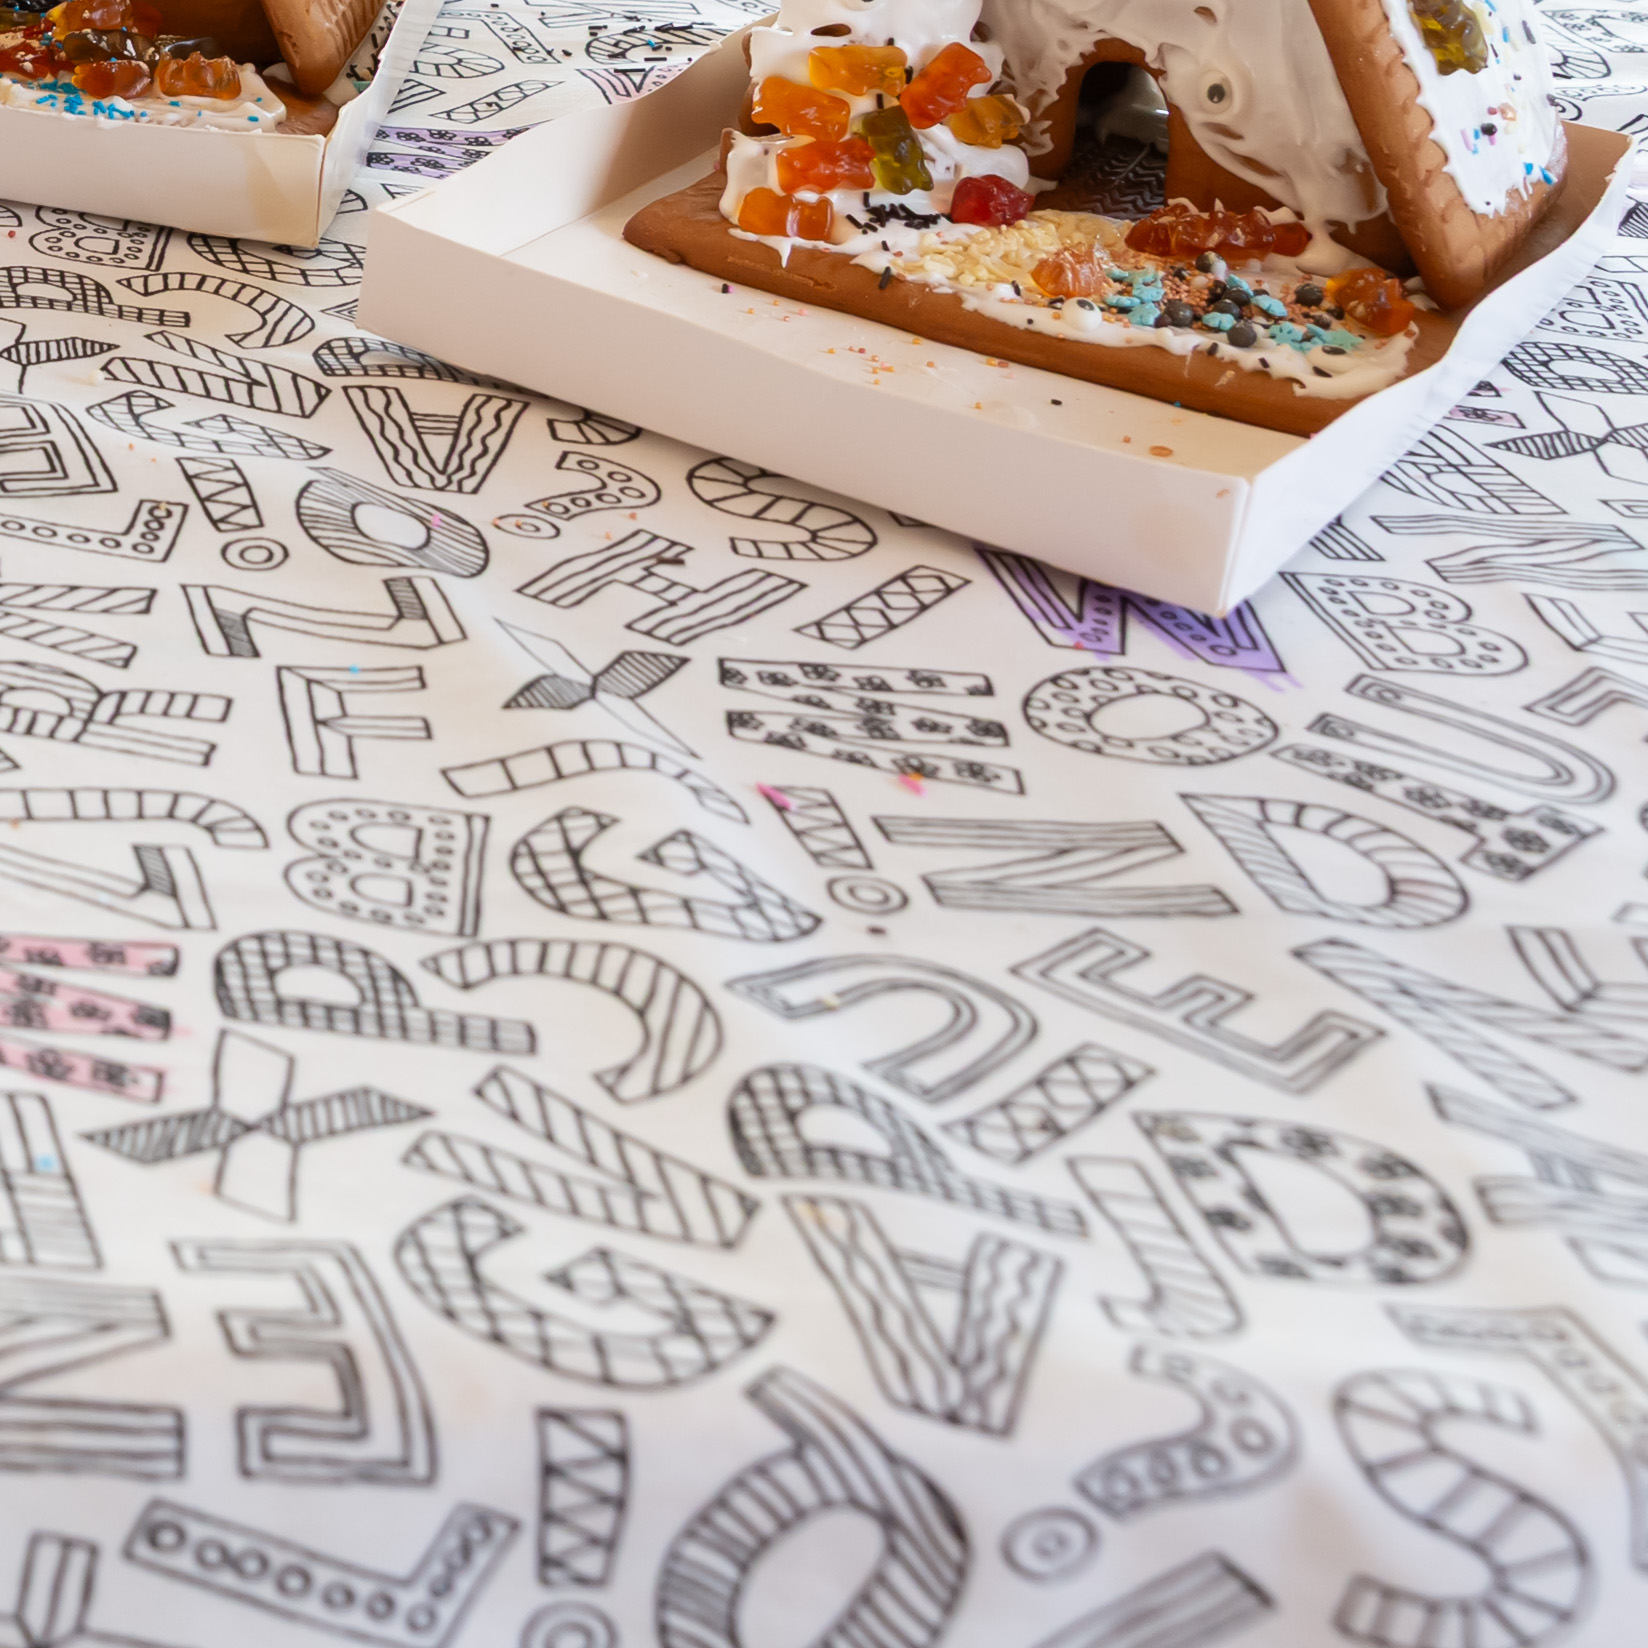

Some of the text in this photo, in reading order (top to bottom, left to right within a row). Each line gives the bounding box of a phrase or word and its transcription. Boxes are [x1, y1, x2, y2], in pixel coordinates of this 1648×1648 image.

[1279, 570, 1530, 677] B
[276, 666, 431, 779] F
[1022, 666, 1281, 764] O
[1181, 792, 1469, 930] D
[1009, 928, 1389, 1094] E
[79, 1029, 434, 1224] X
[1132, 1111, 1469, 1287] D
[1067, 1156, 1248, 1339] J
